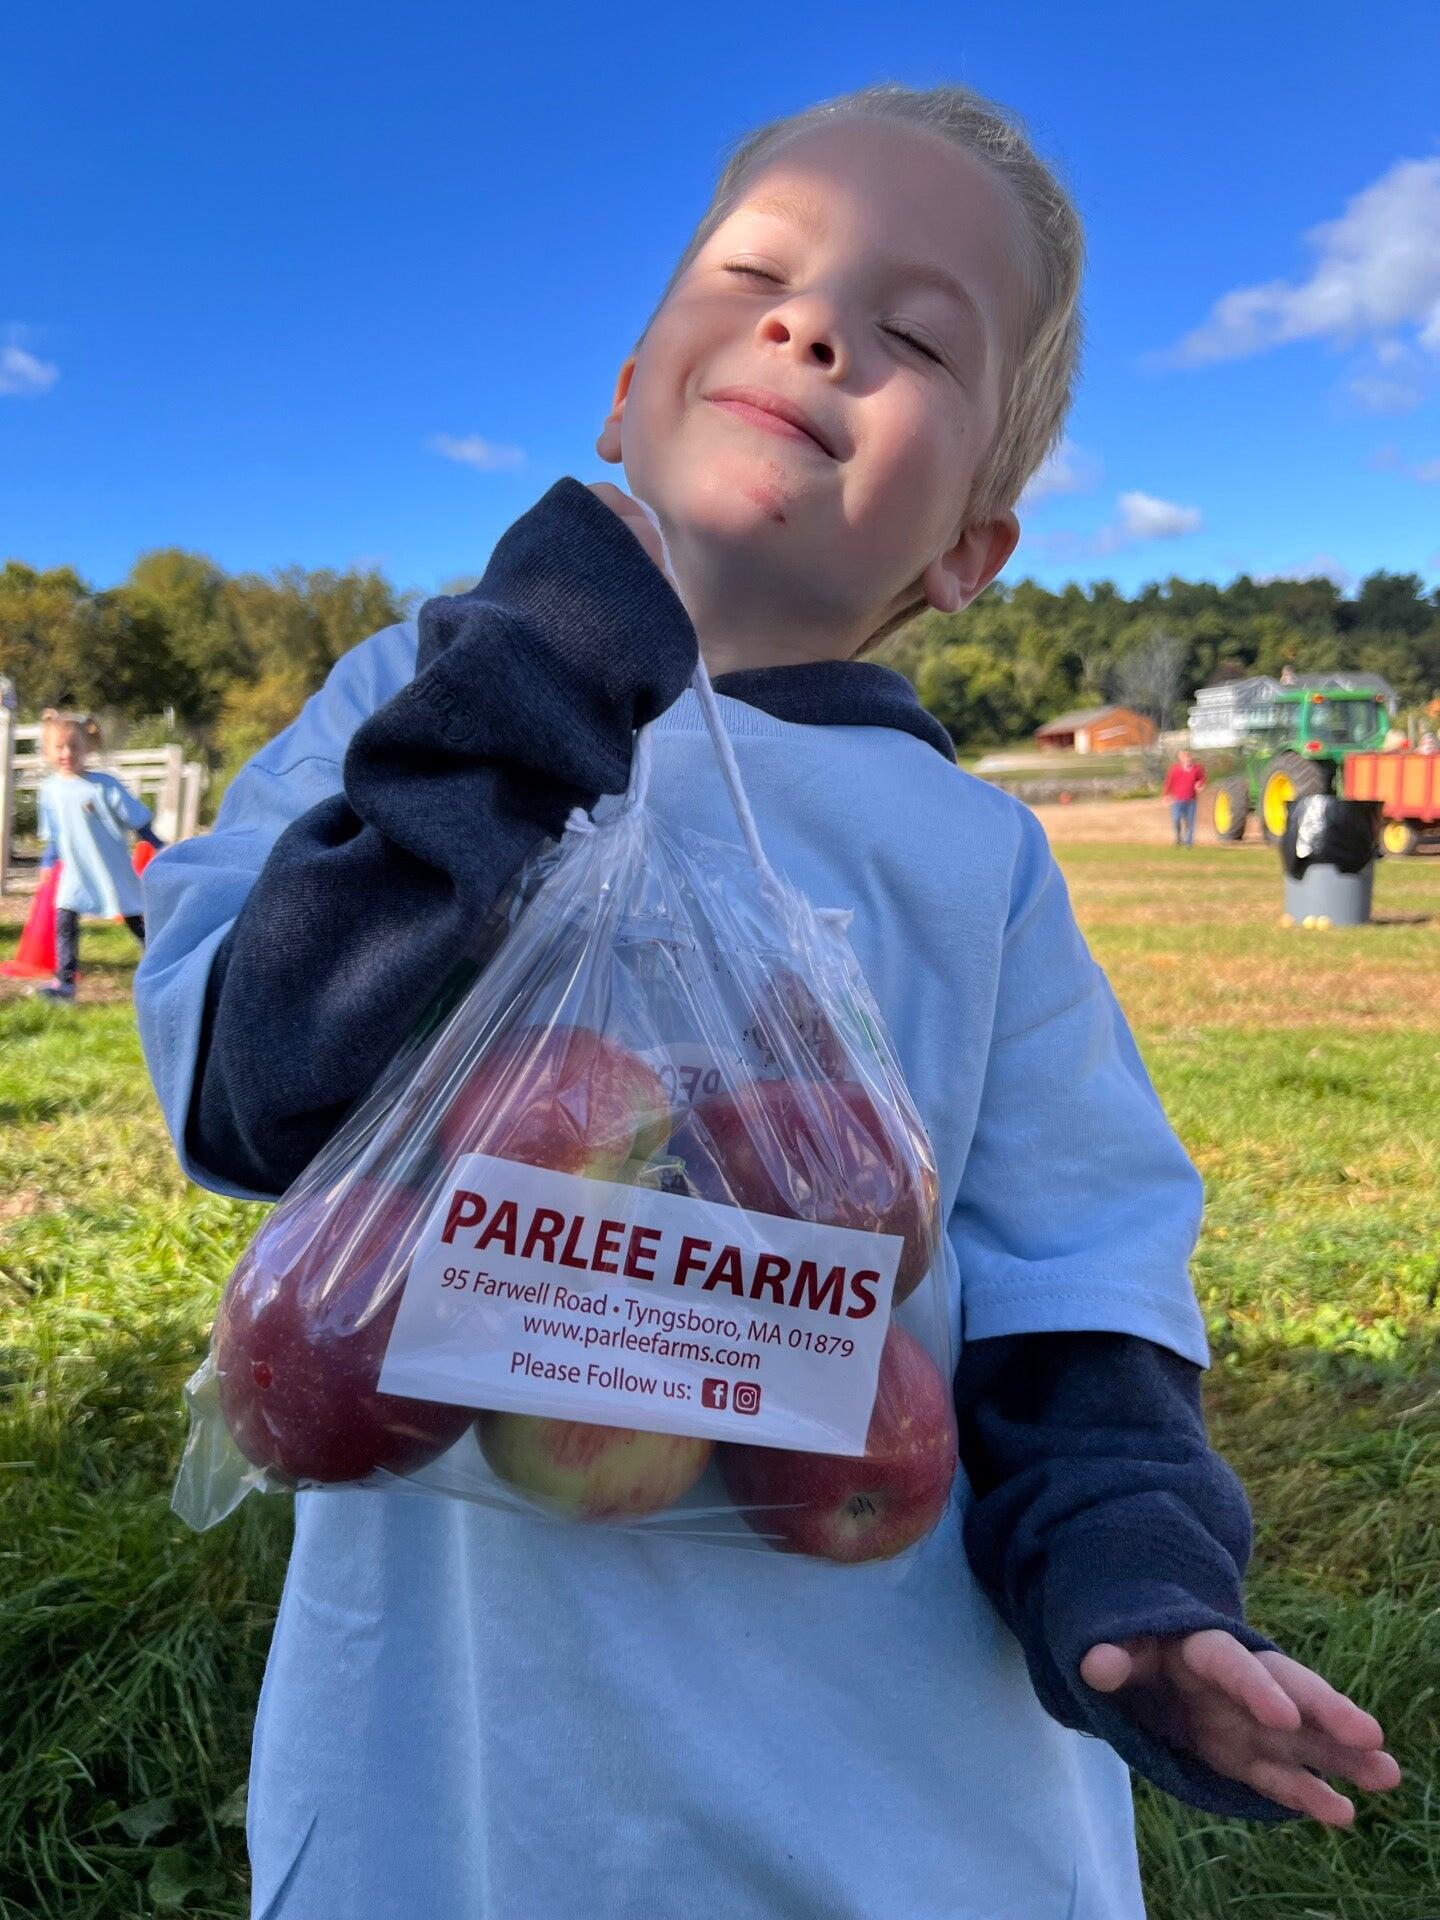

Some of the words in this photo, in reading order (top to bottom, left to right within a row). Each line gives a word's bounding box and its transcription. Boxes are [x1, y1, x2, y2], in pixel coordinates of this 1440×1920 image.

[440, 1190, 663, 1281] PARLEE
[673, 1235, 880, 1320] FARMS
[441, 1267, 470, 1290] 95
[472, 1271, 551, 1306] Farwell
[553, 1286, 607, 1316] Road
[624, 1298, 742, 1341] Tyngsboro,
[747, 1320, 782, 1345] MA
[788, 1328, 855, 1359] 01879
[522, 1316, 761, 1370] www.parleefarms.com
[510, 1351, 581, 1384] Please
[586, 1364, 658, 1395] Follow
[662, 1378, 692, 1400] us:
